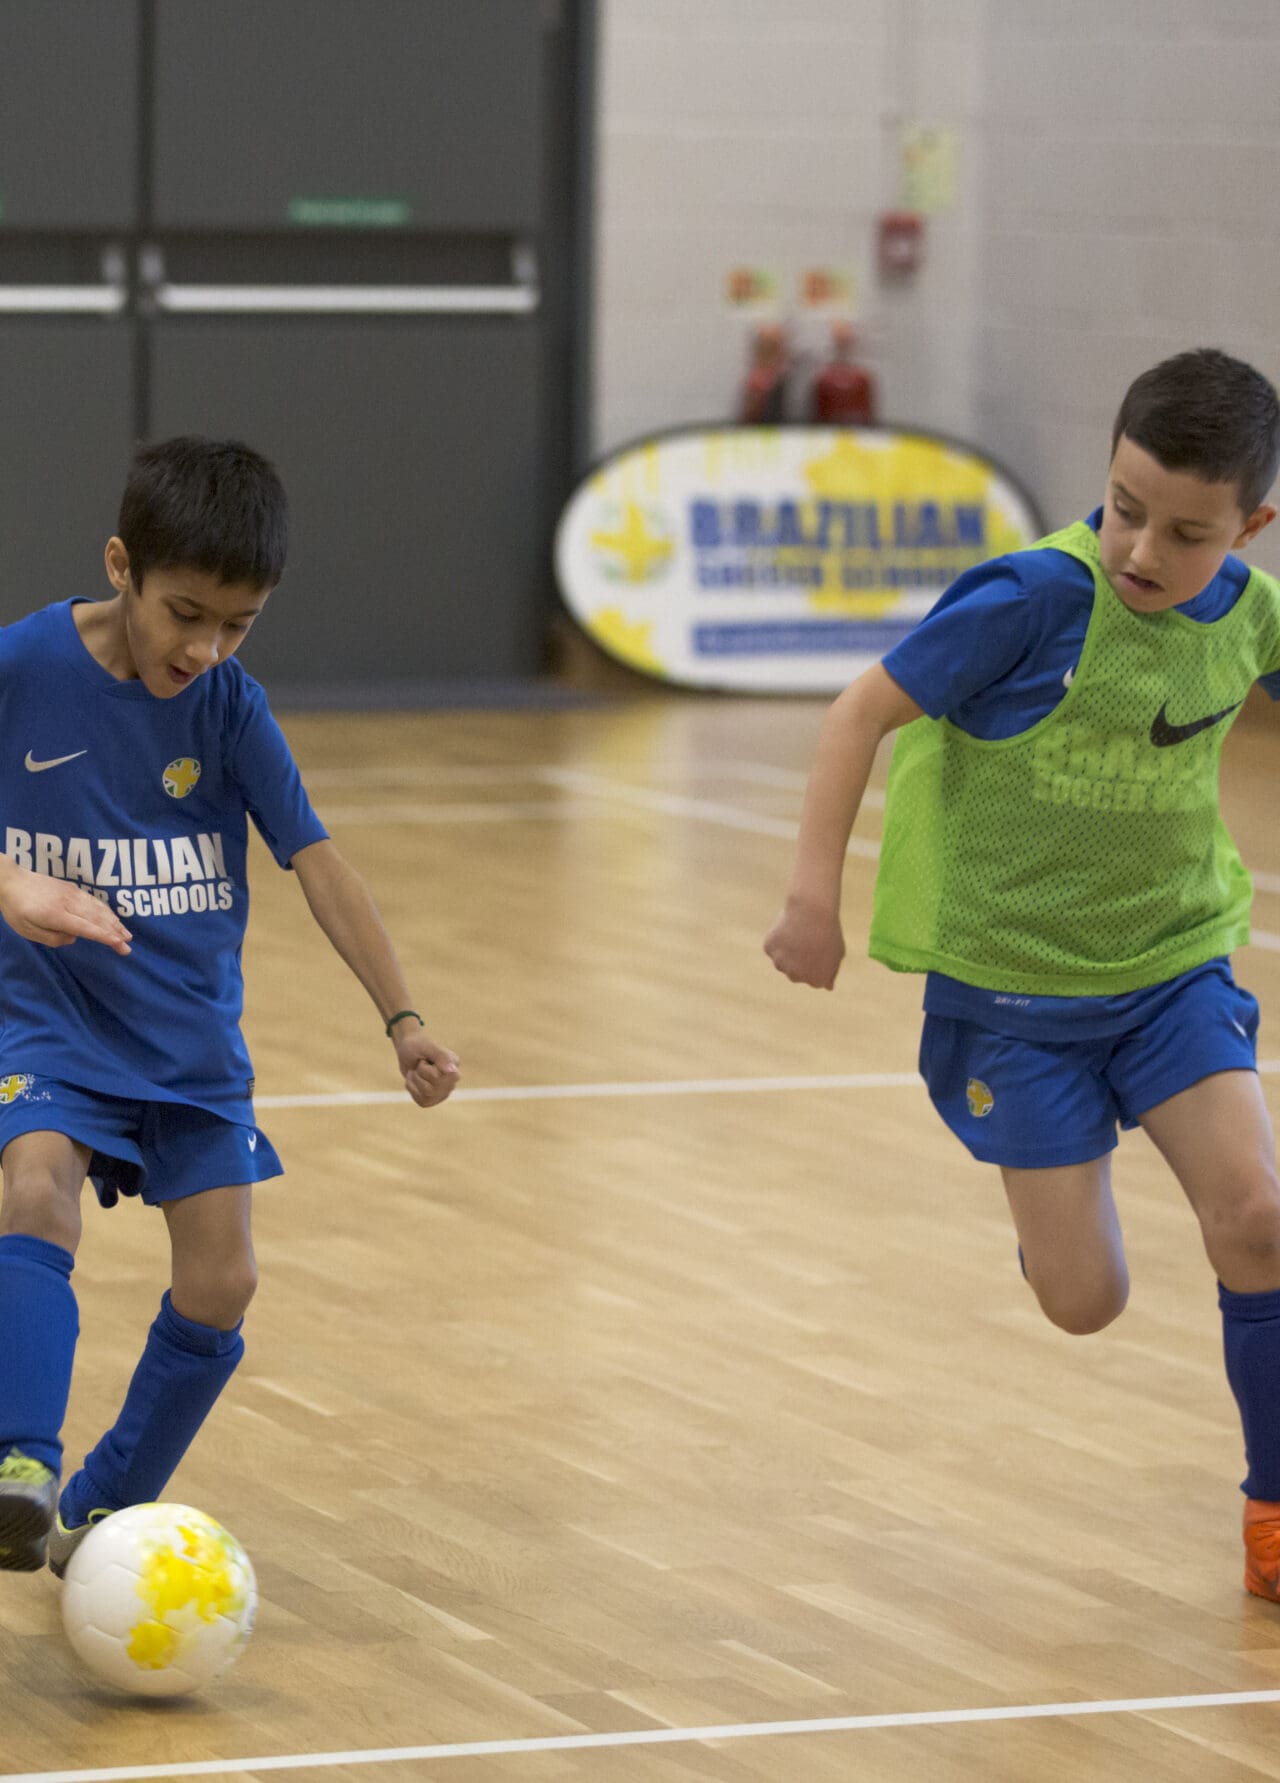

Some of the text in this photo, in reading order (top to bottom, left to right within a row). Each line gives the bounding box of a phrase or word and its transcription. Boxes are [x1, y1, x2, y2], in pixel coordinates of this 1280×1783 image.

[690, 498, 985, 548] BRAZILIAN
[6, 827, 228, 886] BRAZILIAN
[117, 881, 233, 917] SCHOOLS
